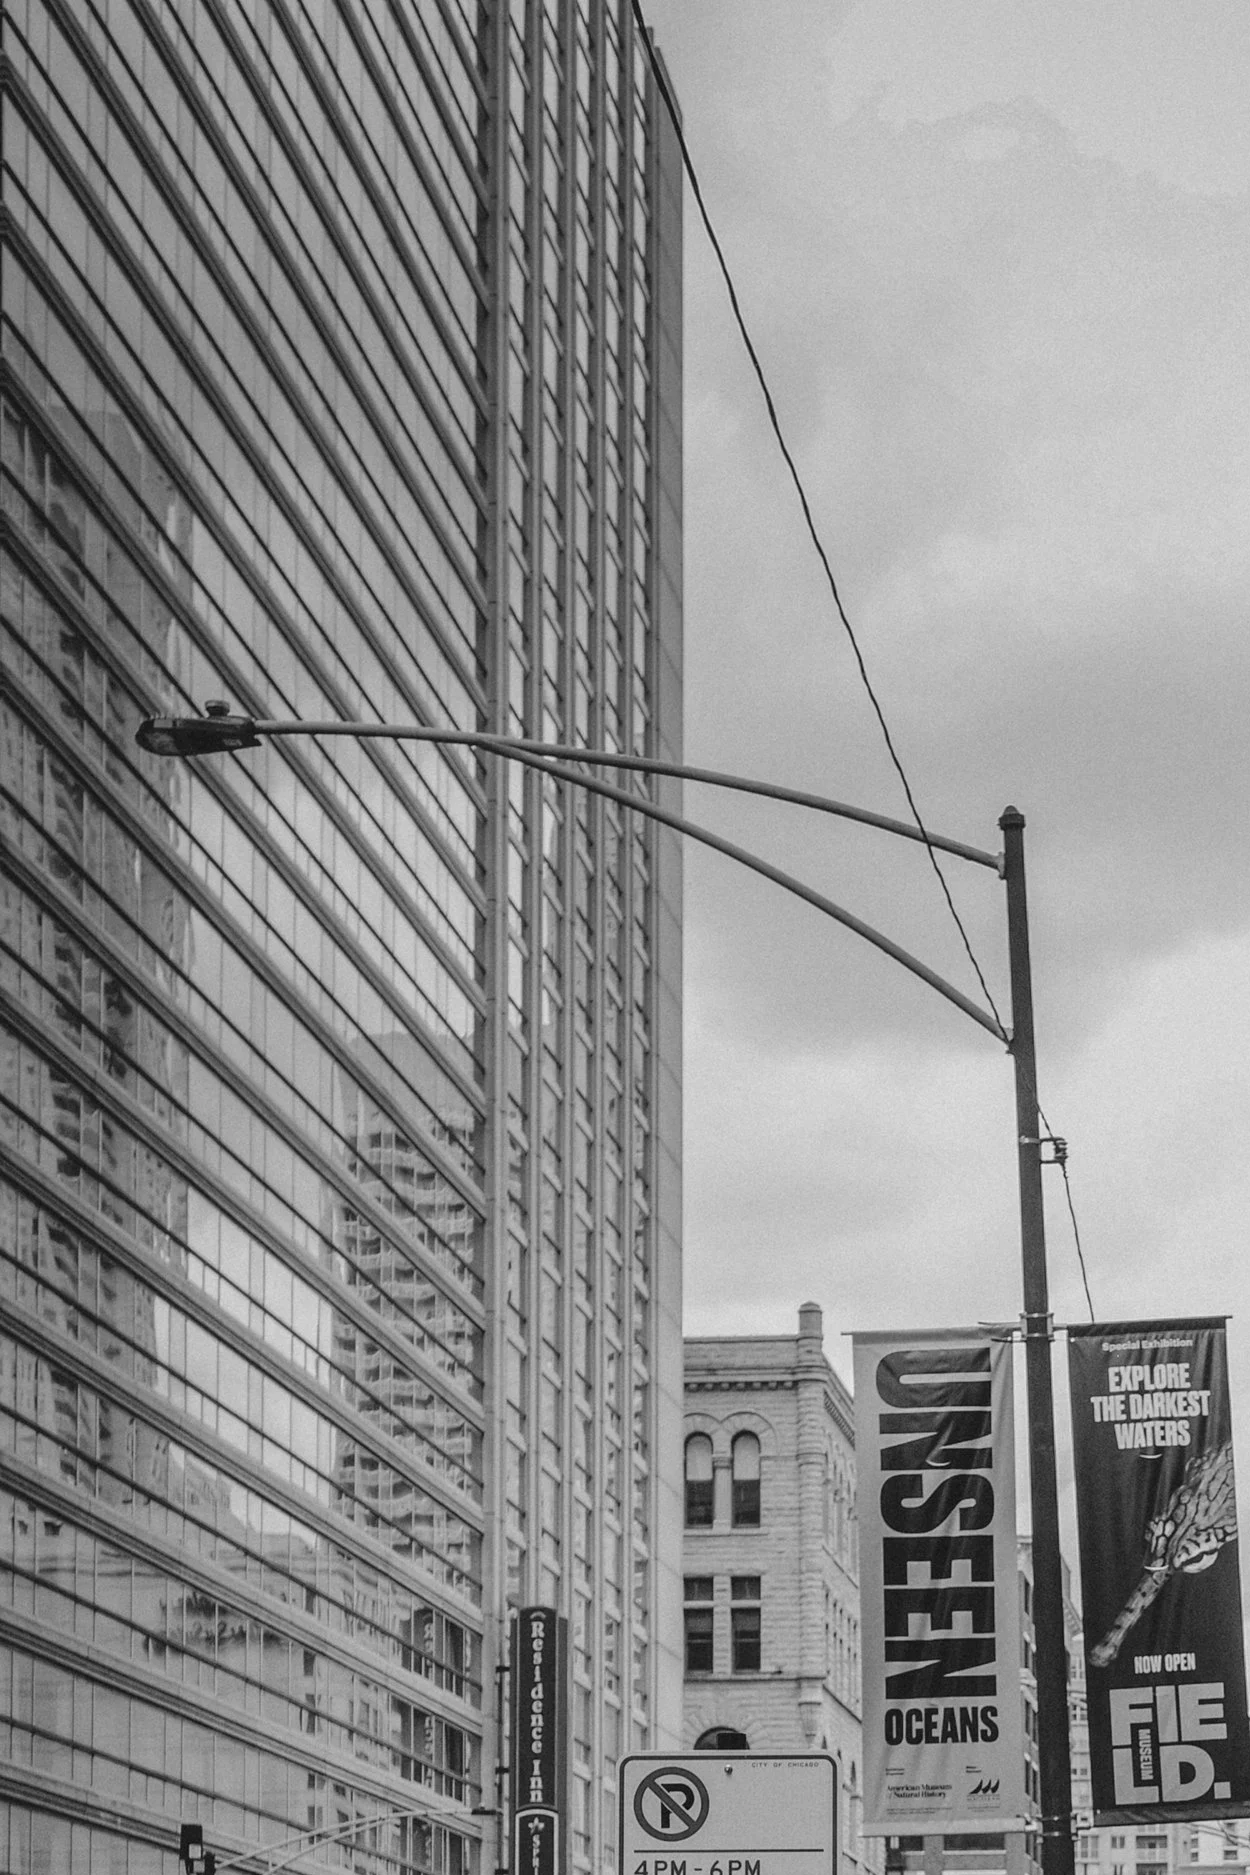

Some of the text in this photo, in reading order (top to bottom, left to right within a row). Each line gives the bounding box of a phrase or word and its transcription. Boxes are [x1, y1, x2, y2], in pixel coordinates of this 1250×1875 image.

[1101, 1337, 1194, 1352] Special Exhibition
[1108, 1362, 1192, 1393] EXPLORE
[1090, 1390, 1211, 1423] THE DARKEST
[1114, 1419, 1191, 1450] WATERS
[876, 1347, 998, 1700] UNSEEN
[1134, 1652, 1197, 1675] NOW OPEN
[529, 1621, 546, 1803] Residence Inn
[884, 1706, 1000, 1746] OCEANS
[751, 1761, 820, 1769] CITY OF CHICAGO
[1138, 1728, 1154, 1781] MUSEUM
